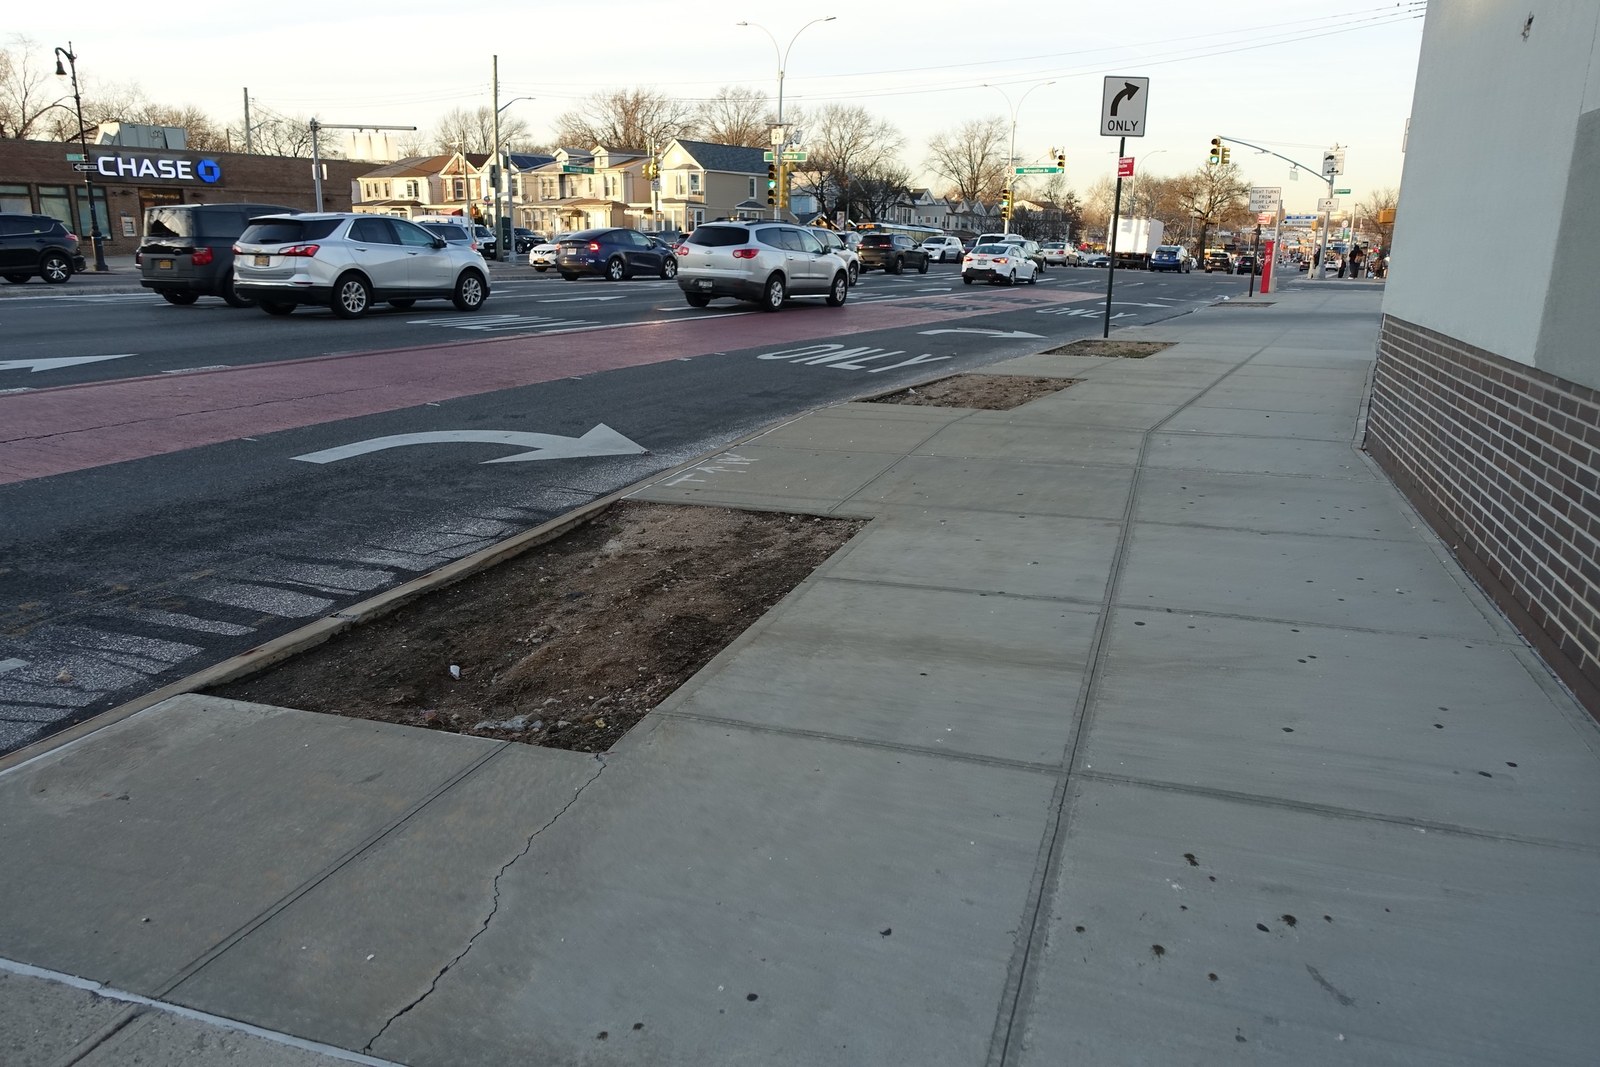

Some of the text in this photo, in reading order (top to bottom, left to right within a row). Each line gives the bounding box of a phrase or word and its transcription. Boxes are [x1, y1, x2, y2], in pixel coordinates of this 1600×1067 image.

[1107, 120, 1139, 132] ONLY
[97, 156, 194, 180] CHASE
[1036, 307, 1138, 320] ONLY
[757, 344, 953, 374] ONLY
